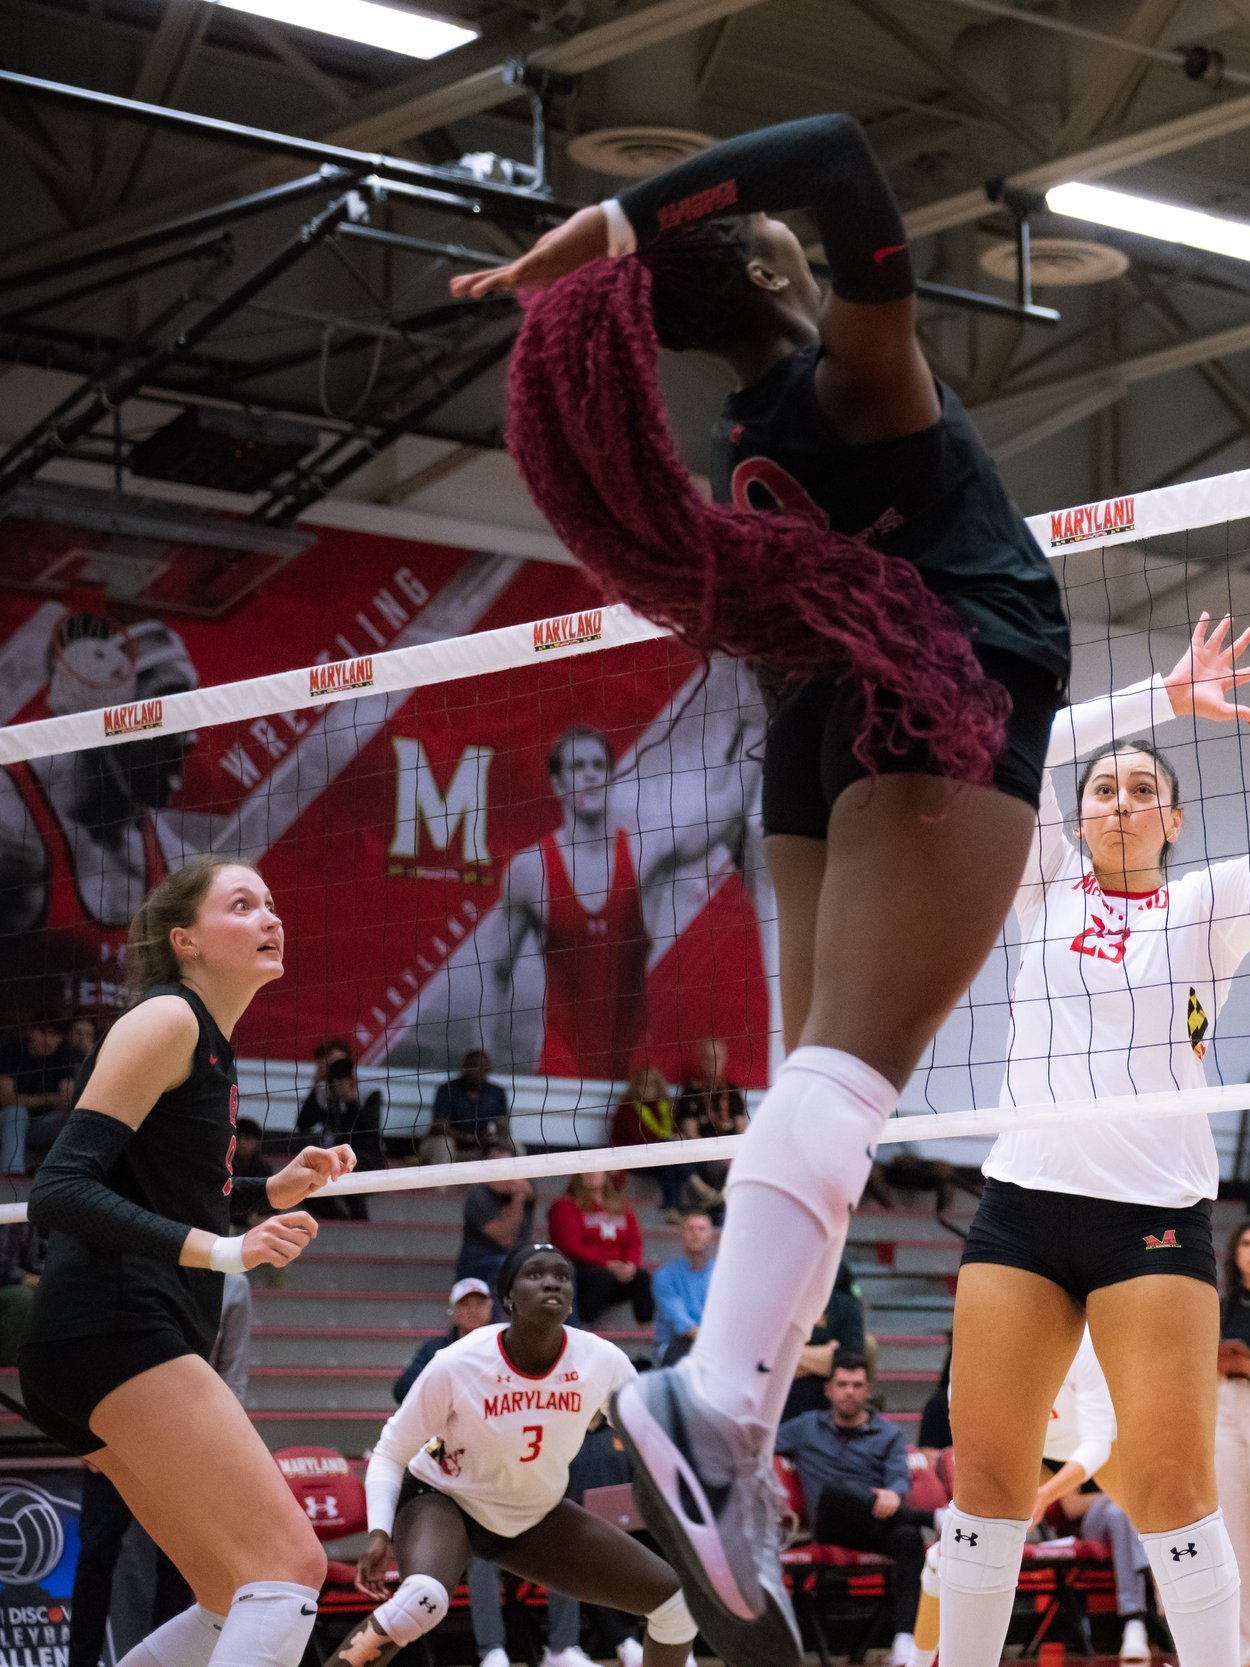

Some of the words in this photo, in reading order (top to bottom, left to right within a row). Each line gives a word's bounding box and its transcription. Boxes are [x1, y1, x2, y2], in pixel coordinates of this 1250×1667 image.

[1051, 497, 1135, 541] MARYLAND
[533, 609, 603, 646] MARYLAND
[309, 657, 373, 691] MARYLAND
[103, 699, 163, 732] MARYLAND
[389, 735, 495, 866] M
[484, 1389, 582, 1420] MARYLAND
[519, 1425, 543, 1463] 3
